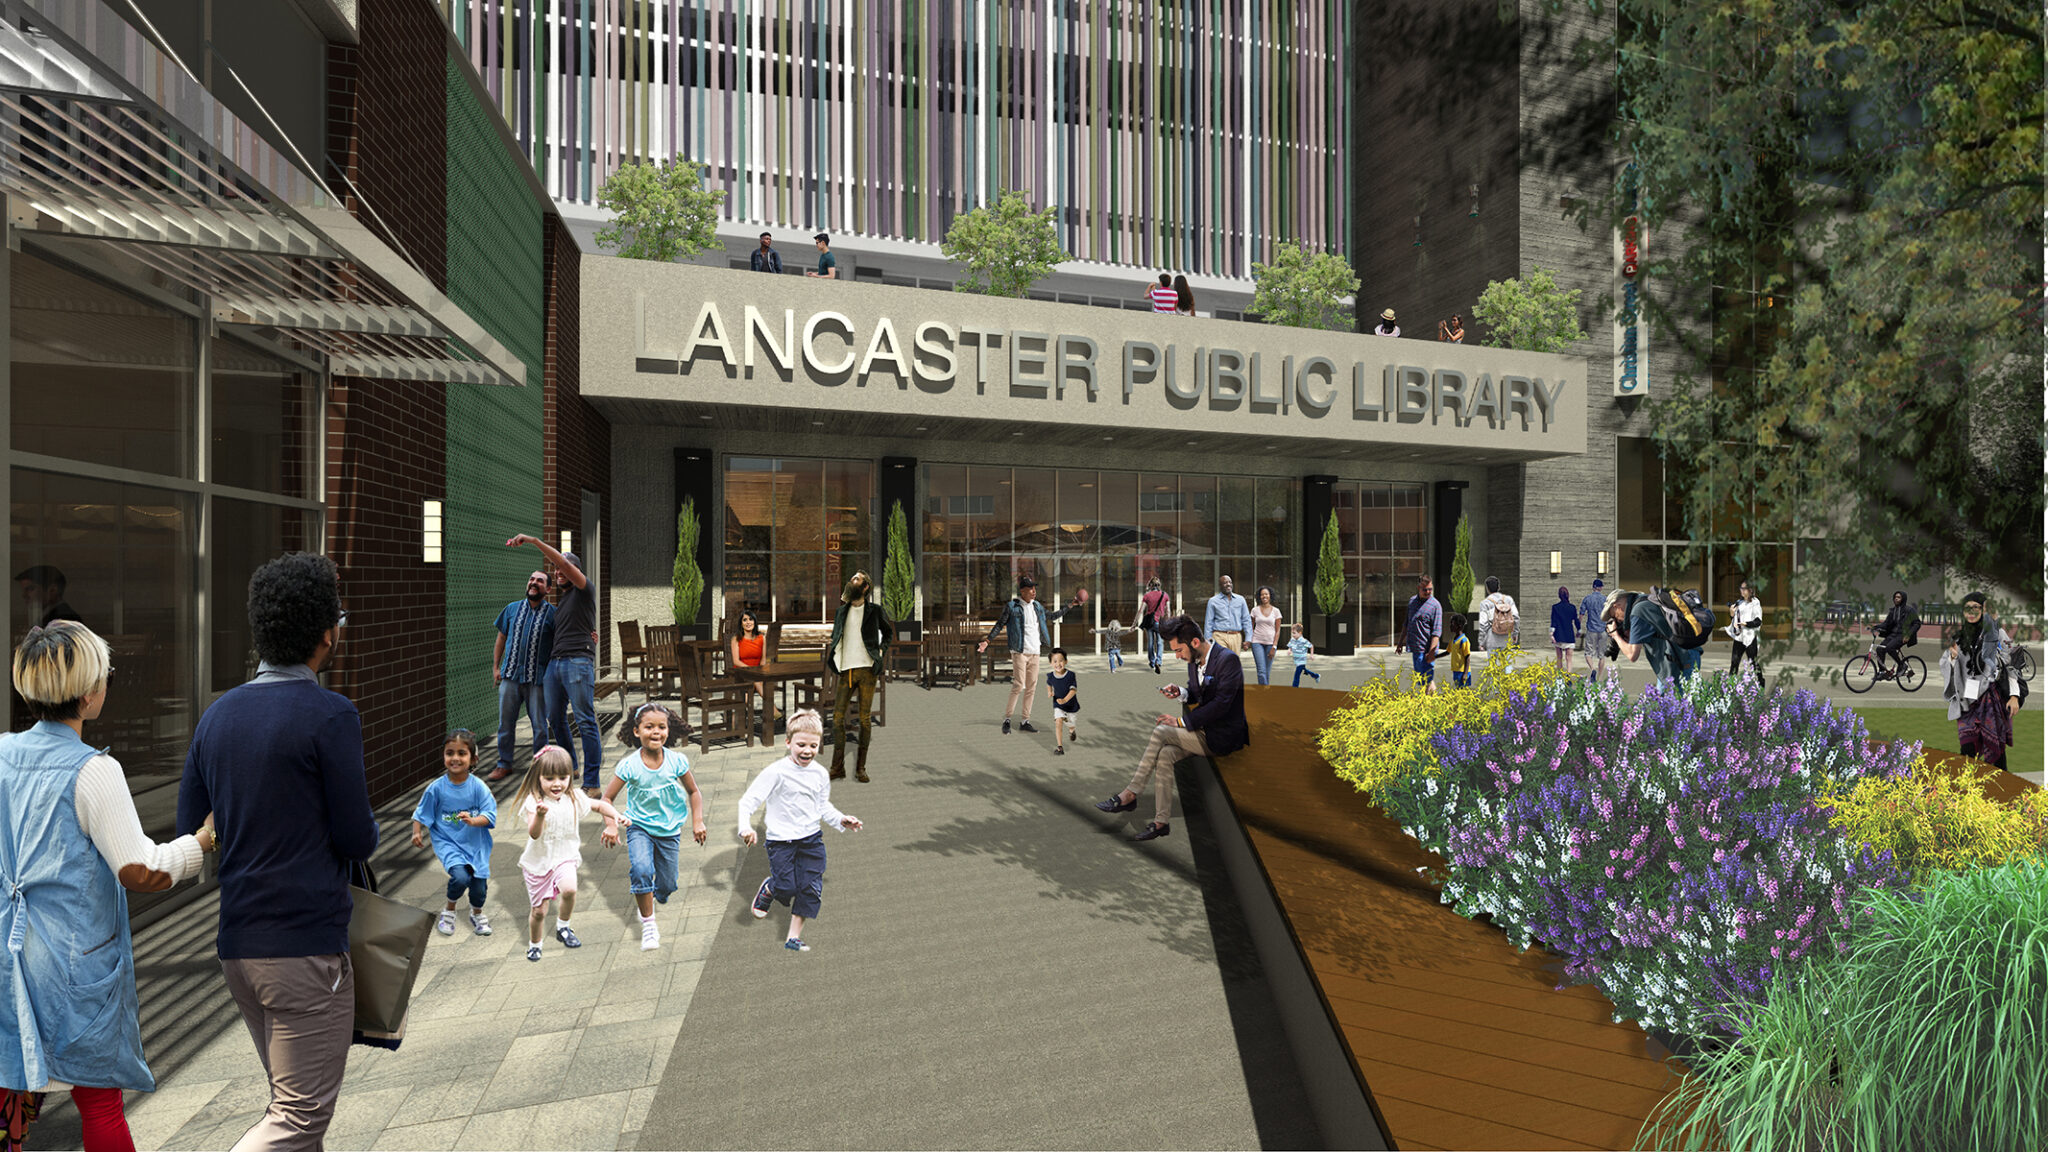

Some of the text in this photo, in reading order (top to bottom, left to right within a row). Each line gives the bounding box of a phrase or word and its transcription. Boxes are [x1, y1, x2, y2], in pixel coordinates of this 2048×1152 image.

[635, 294, 1567, 428] LANCASTER PUBLIC LIBRARY
[828, 523, 840, 581] ERVICE
